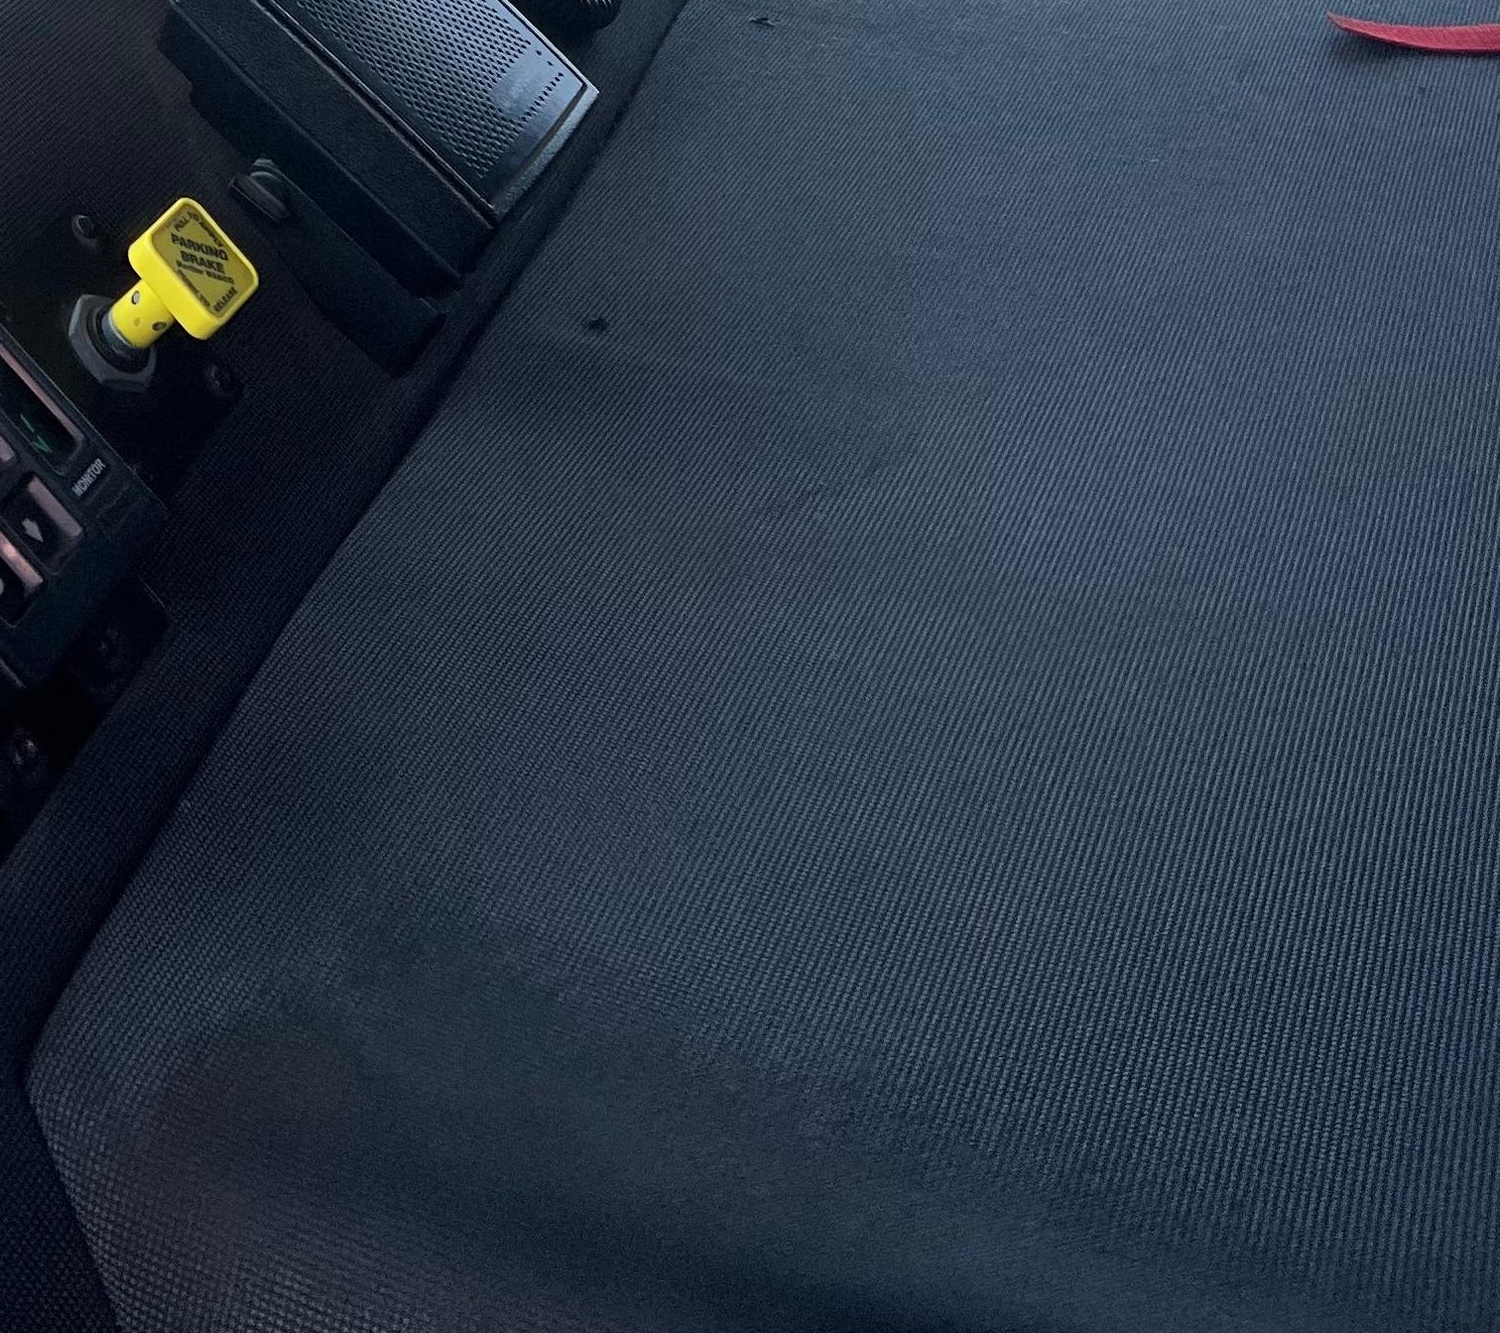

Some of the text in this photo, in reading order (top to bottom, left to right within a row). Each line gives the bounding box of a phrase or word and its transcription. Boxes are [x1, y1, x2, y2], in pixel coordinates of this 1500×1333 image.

[171, 233, 229, 261] PARKING
[180, 251, 225, 274] BRAKE
[214, 286, 238, 313] RELEASE
[71, 457, 106, 496] MONITOR
